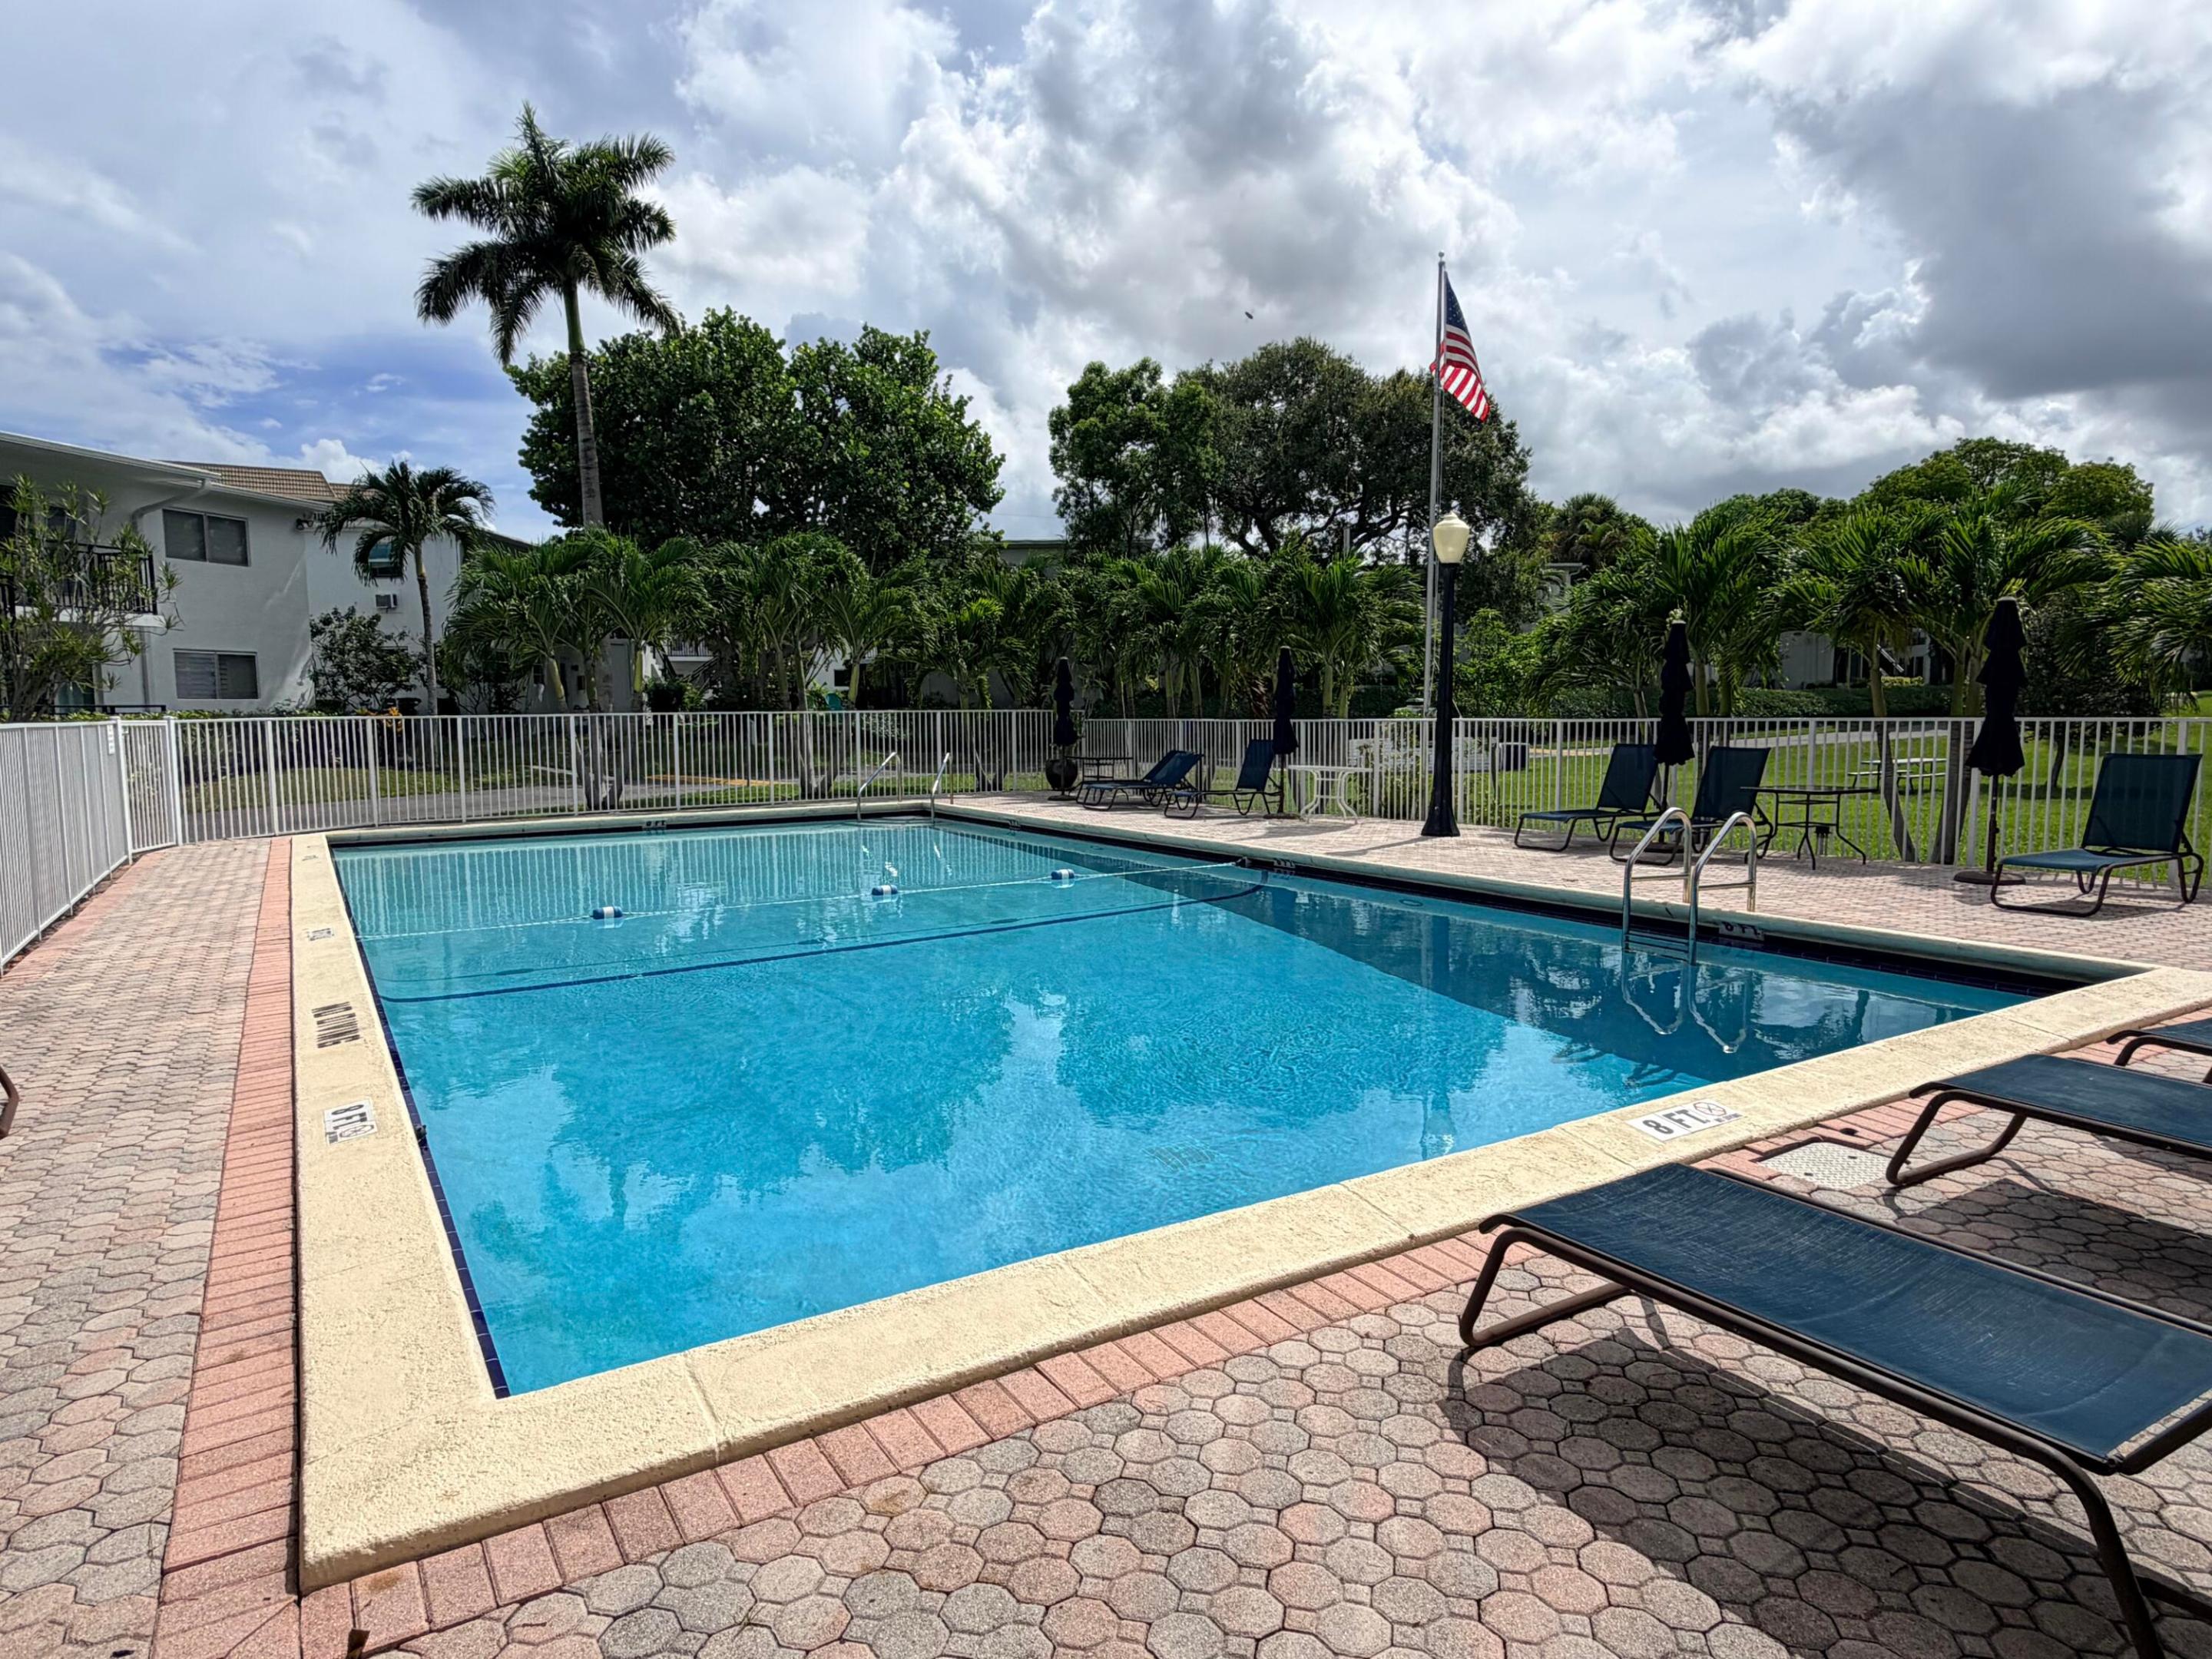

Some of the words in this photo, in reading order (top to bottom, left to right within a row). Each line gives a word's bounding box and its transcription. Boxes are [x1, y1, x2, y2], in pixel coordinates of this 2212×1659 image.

[311, 1001, 353, 1018] NO
[316, 1012, 361, 1048] DIVING
[331, 1104, 364, 1115] 8
[1642, 1119, 1674, 1134] 8
